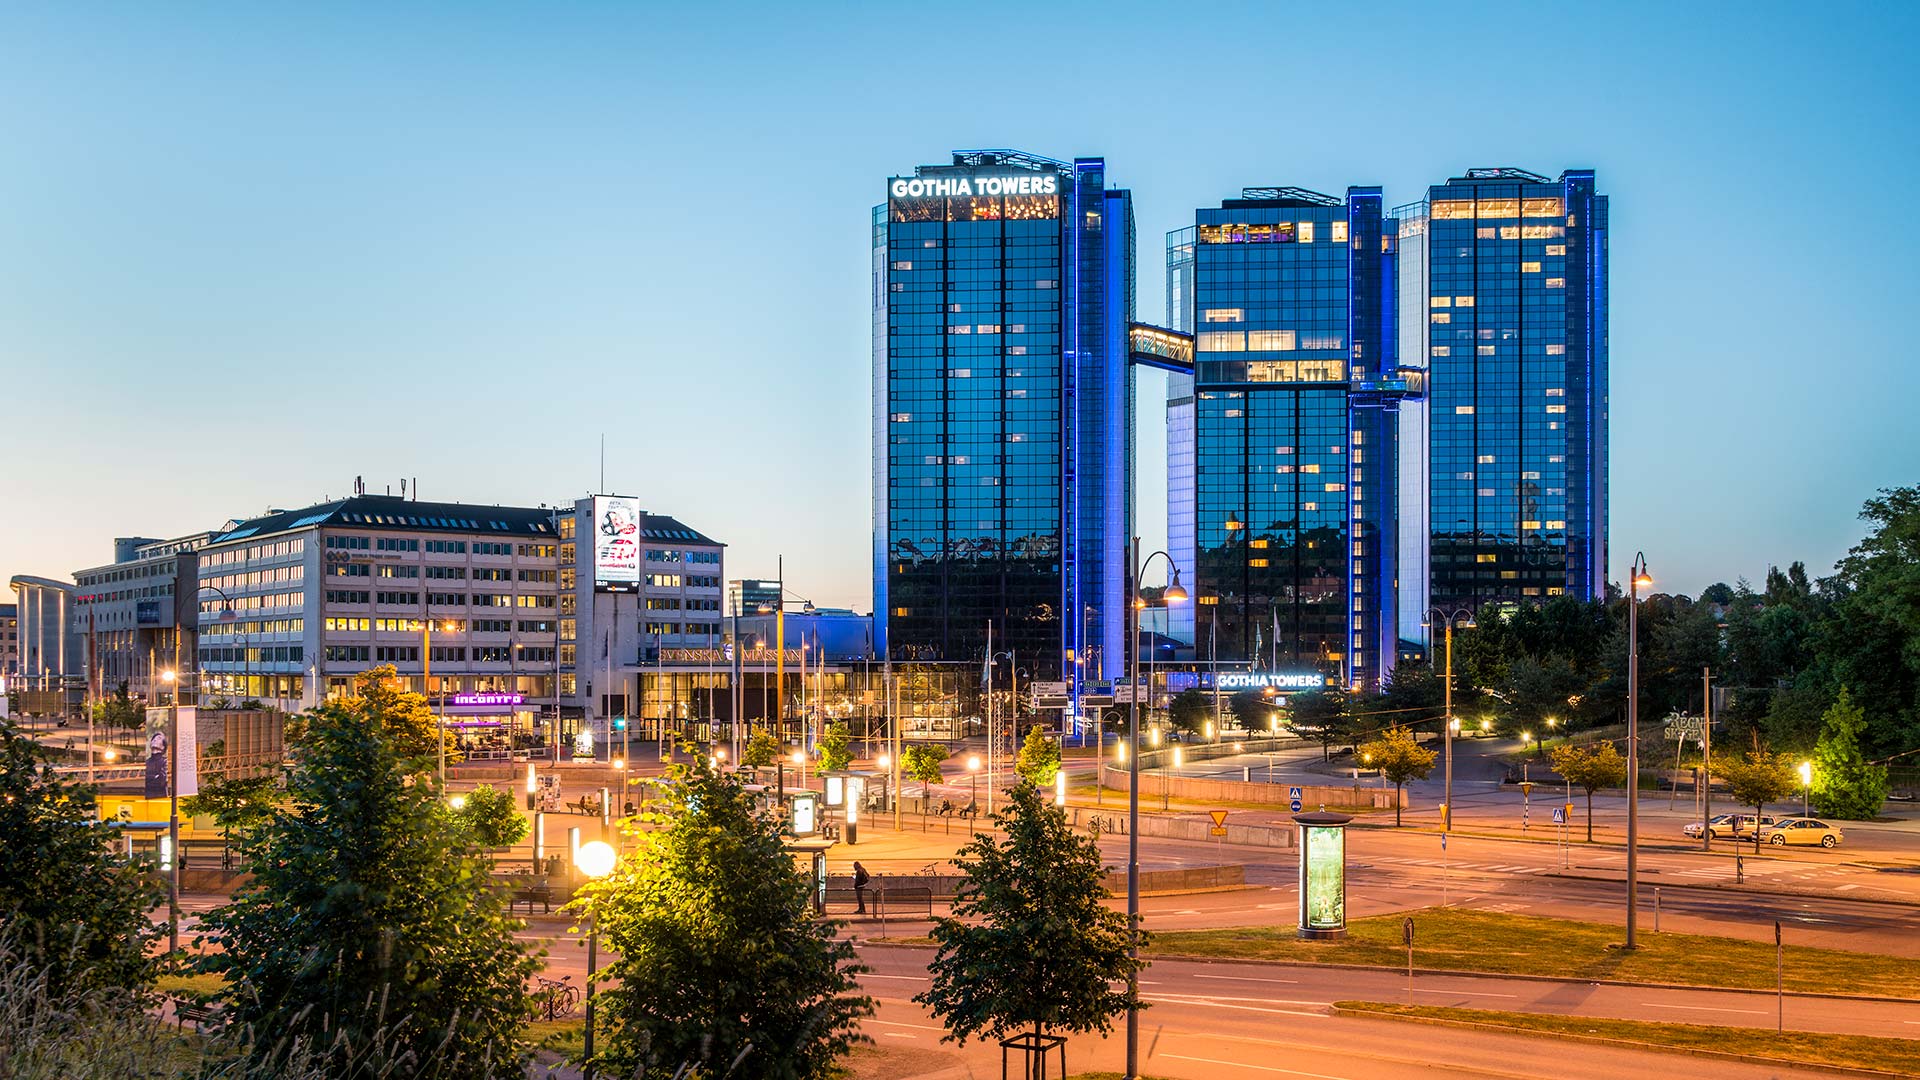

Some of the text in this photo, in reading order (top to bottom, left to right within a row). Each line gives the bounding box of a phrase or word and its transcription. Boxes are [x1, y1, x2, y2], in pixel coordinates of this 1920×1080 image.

[892, 176, 1056, 197] GOTHIA TOWERS
[658, 648, 722, 661] SVENSKA
[1218, 674, 1322, 687] GOTHIA TOWERS
